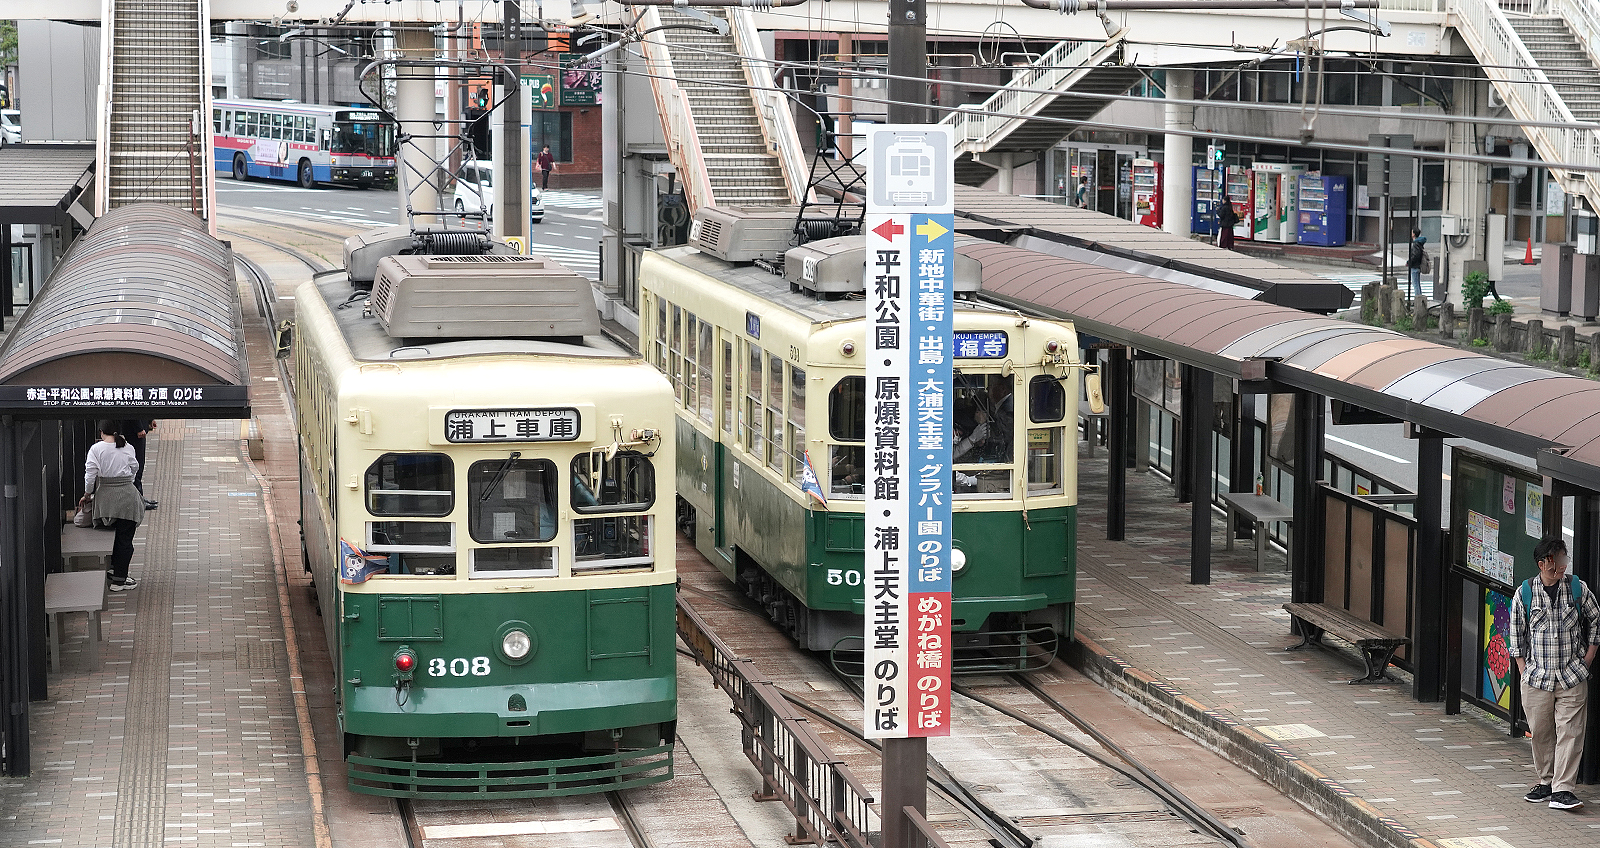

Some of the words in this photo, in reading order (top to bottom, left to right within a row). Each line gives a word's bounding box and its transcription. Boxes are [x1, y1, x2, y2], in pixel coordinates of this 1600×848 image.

[529, 79, 540, 88] PUB
[953, 339, 1003, 357] 福寺
[26, 387, 144, 401] 赤迫・平和公園・原爆資料館
[148, 387, 168, 401] 方面
[173, 387, 203, 401] のりば
[917, 248, 945, 536] 新地中華街・出島・大浦天主堂・グラバー園
[454, 411, 499, 419] URAKAMI
[449, 417, 573, 440] 浦上車庫
[874, 249, 901, 650] 平和公園・原爆資料館・浦上天主堂
[917, 540, 943, 582] のりば
[827, 568, 865, 586] 50
[916, 596, 943, 669] めがね橋
[428, 656, 491, 677] 308
[874, 659, 899, 731] のりば
[916, 675, 942, 729] のりば
